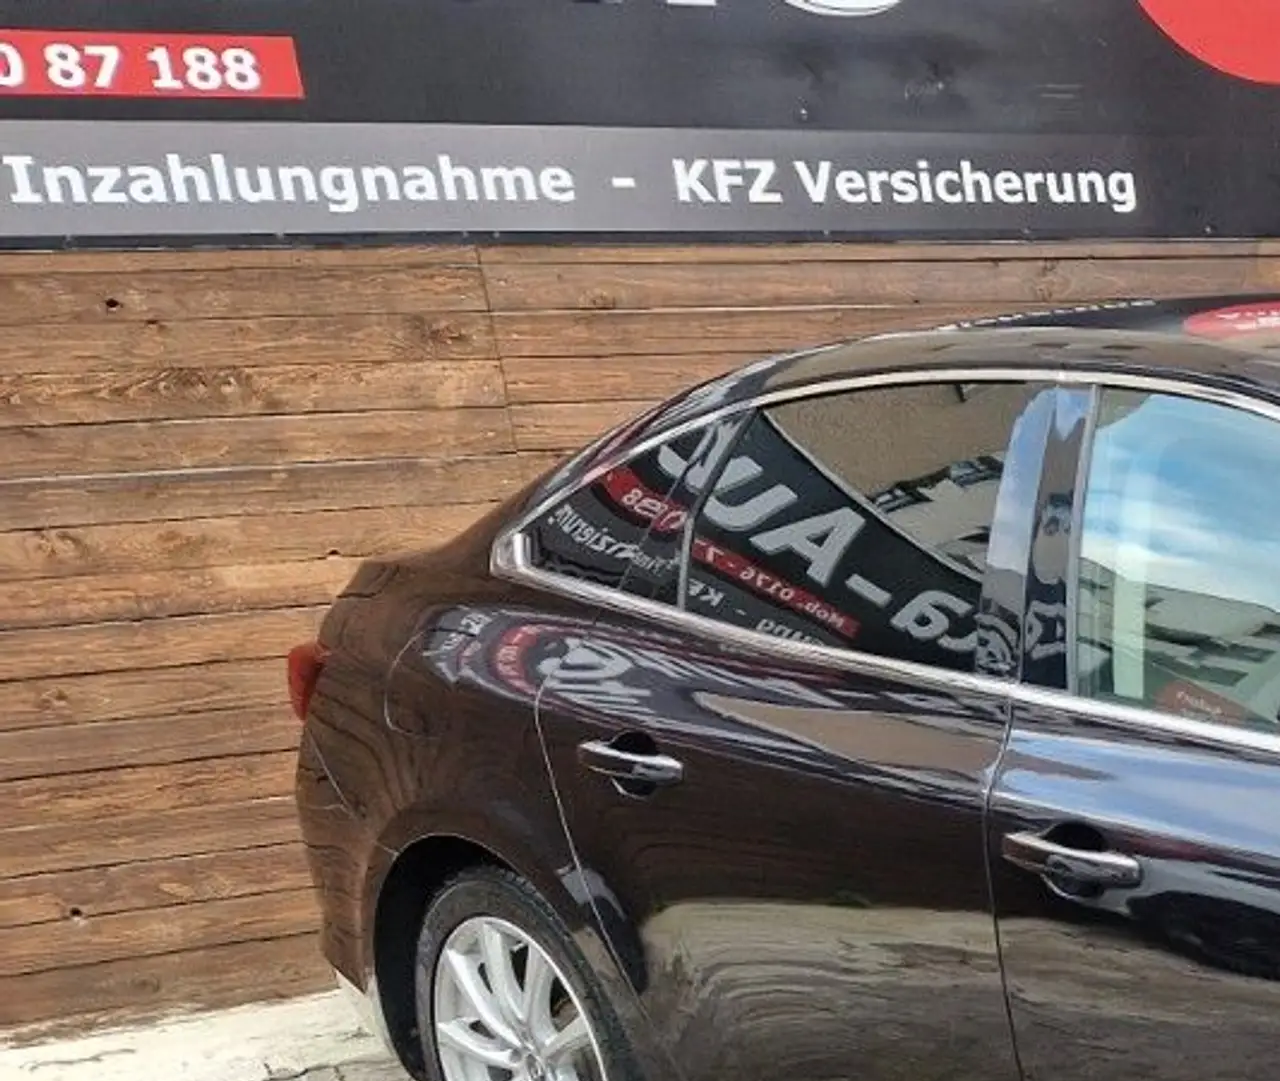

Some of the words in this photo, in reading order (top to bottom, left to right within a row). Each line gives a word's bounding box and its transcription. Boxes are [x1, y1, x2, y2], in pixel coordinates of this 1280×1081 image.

[43, 44, 122, 90] 87
[146, 46, 261, 92] 188
[2, 153, 576, 214] Inzahlungnahme
[673, 158, 783, 205] KFZ
[791, 159, 1138, 213] Versicherung
